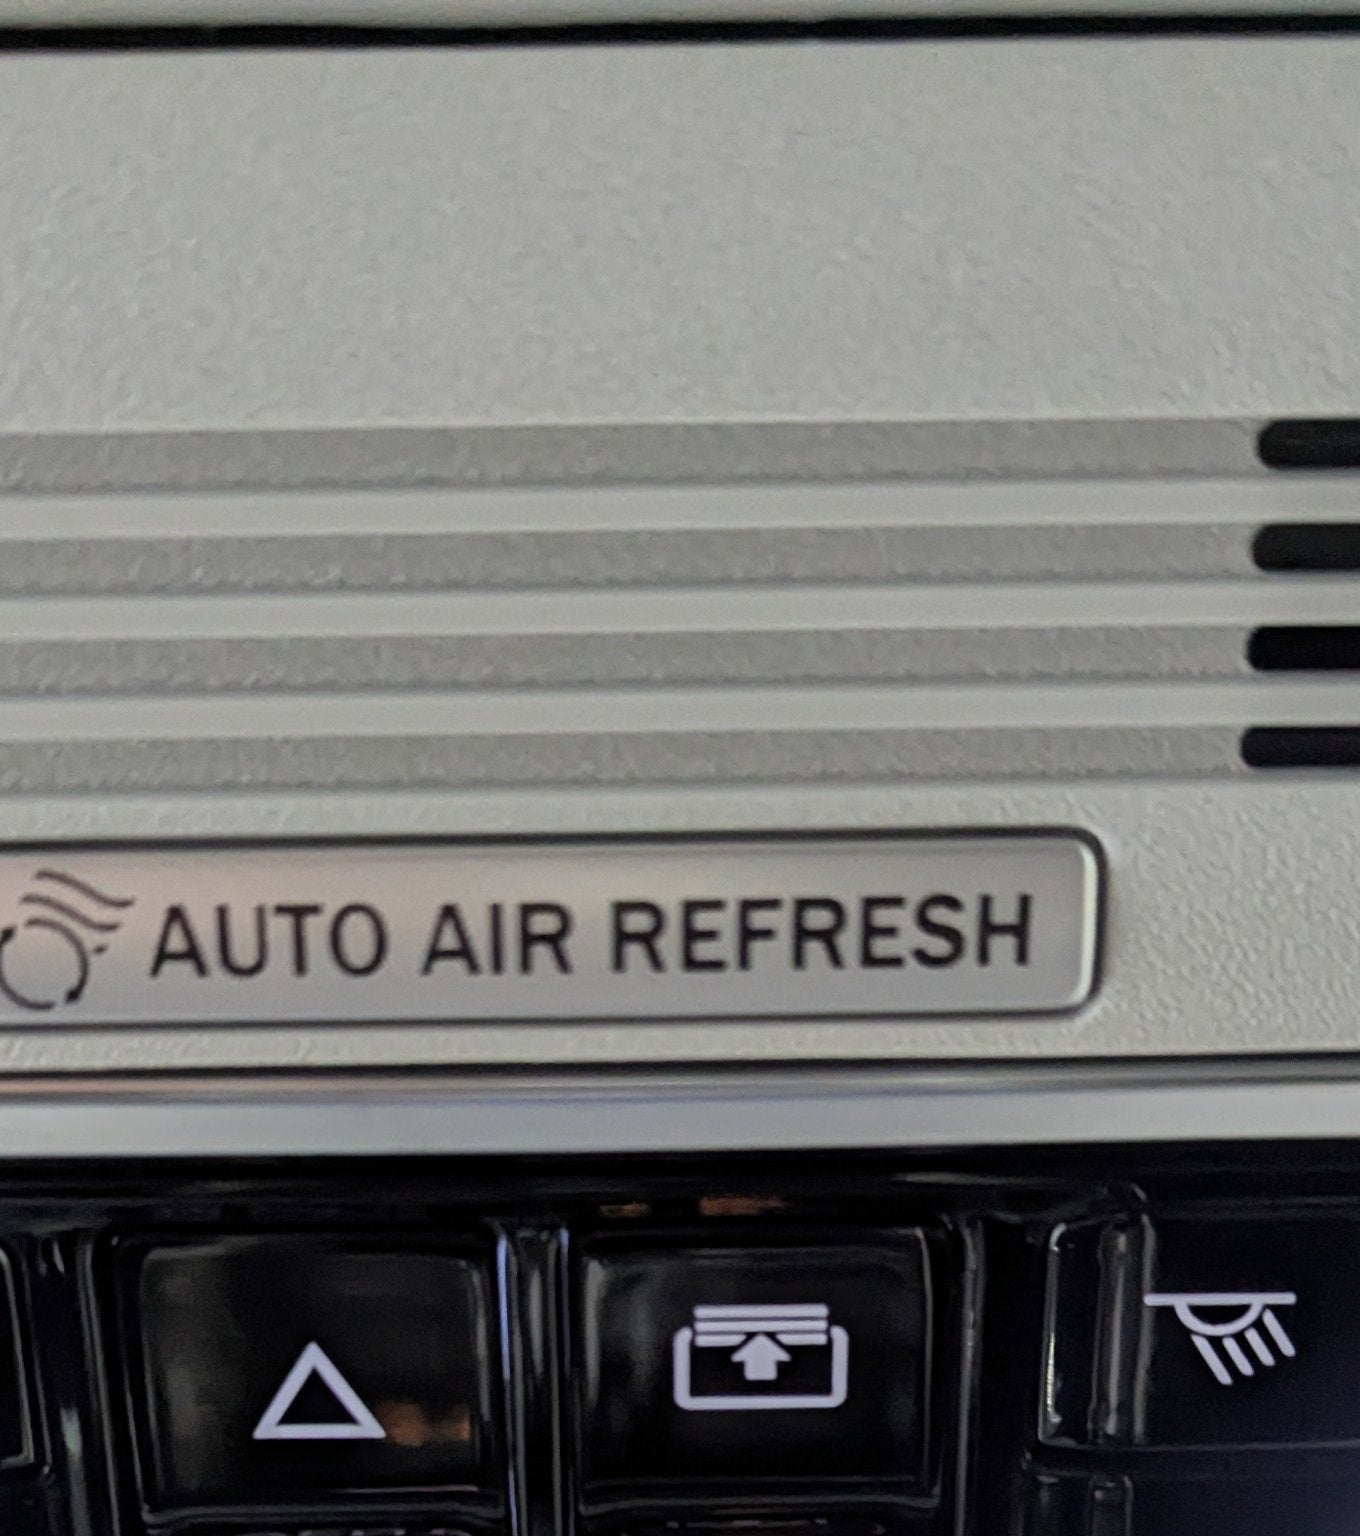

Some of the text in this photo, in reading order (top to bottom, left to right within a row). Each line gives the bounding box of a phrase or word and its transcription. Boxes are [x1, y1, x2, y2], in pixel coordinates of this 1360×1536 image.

[149, 892, 1035, 978] AUTO AIR REFRESH
